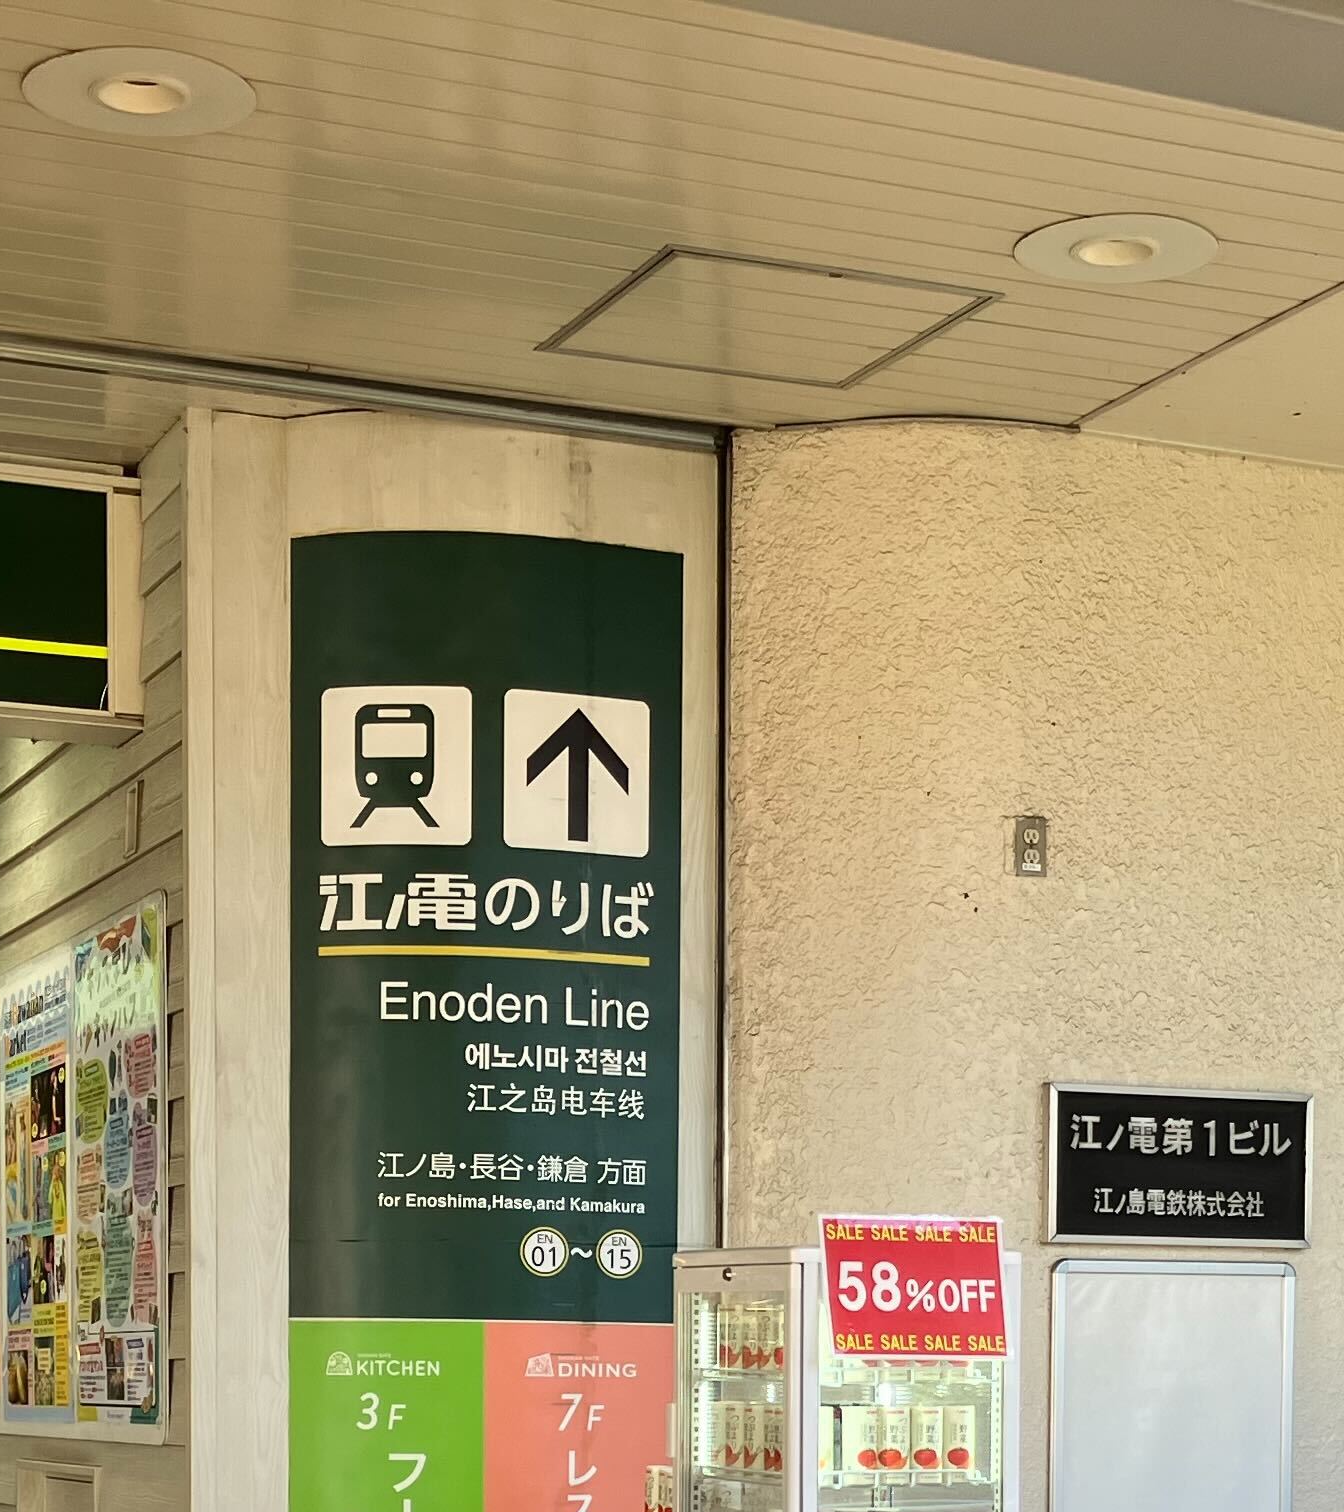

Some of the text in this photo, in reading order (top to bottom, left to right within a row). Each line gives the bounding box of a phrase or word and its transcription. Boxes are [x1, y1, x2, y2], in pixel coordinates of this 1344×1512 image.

[319, 873, 654, 939] 江ノ電のりば
[379, 980, 650, 1031] Enoden Line
[465, 1042, 648, 1077] 에노시마 전철선
[466, 1083, 645, 1120] 江之岛电车线
[377, 1151, 647, 1186] 江ノ島・長谷・鎌倉 方面
[378, 1193, 401, 1208] for
[570, 1197, 645, 1215] Kamakura
[1094, 1188, 1265, 1218] 江ノ島電鉄株式会社
[536, 1234, 627, 1246] EN EN
[826, 1224, 996, 1243] SALE SALE SALE SALE
[531, 1247, 558, 1268] 01
[605, 1248, 632, 1270] 15
[838, 1261, 996, 1313] 58%OFF
[836, 1333, 1005, 1352] SALE SALE SALE SALE
[356, 1360, 440, 1377] KITCHEN
[558, 1363, 637, 1377] DINING
[356, 1392, 406, 1430] 3F
[558, 1393, 605, 1431] 7F
